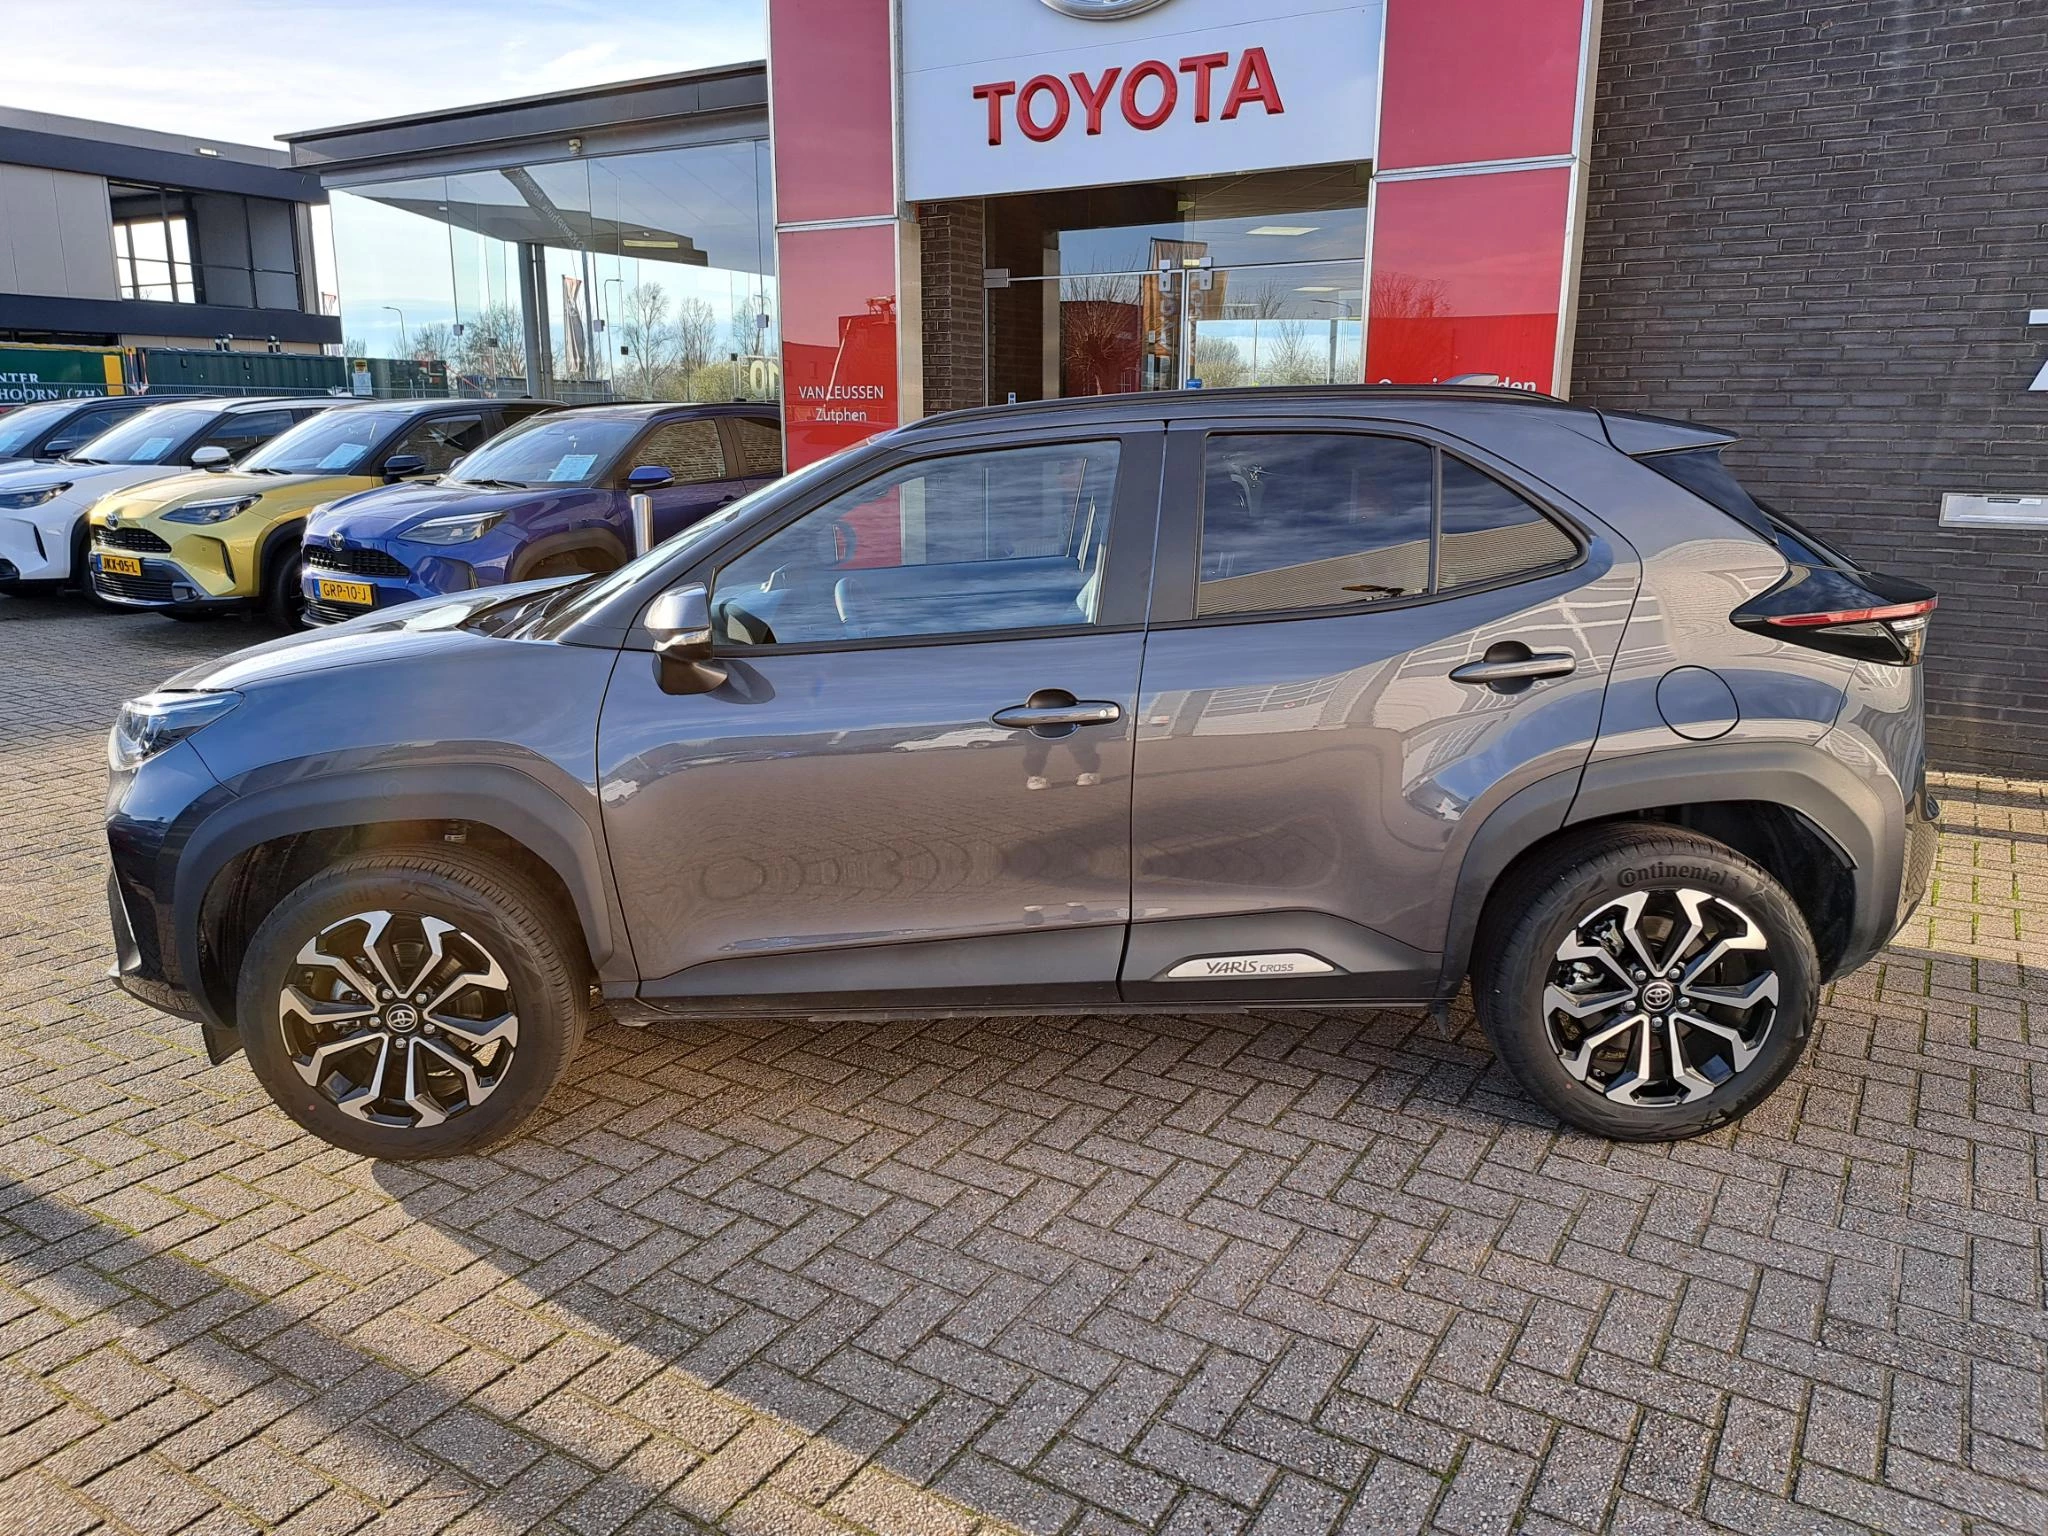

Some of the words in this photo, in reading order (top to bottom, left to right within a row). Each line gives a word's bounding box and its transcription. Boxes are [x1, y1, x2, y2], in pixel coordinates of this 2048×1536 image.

[973, 47, 1284, 146] TOYOTA
[799, 385, 824, 399] VAN
[829, 385, 884, 400] LEUSSEN
[815, 406, 867, 424] Zutphen
[103, 557, 138, 573] JKX-05-L
[323, 583, 367, 601] GRP-10-J
[1617, 861, 1728, 888] Continental
[1260, 963, 1294, 973] CROSS
